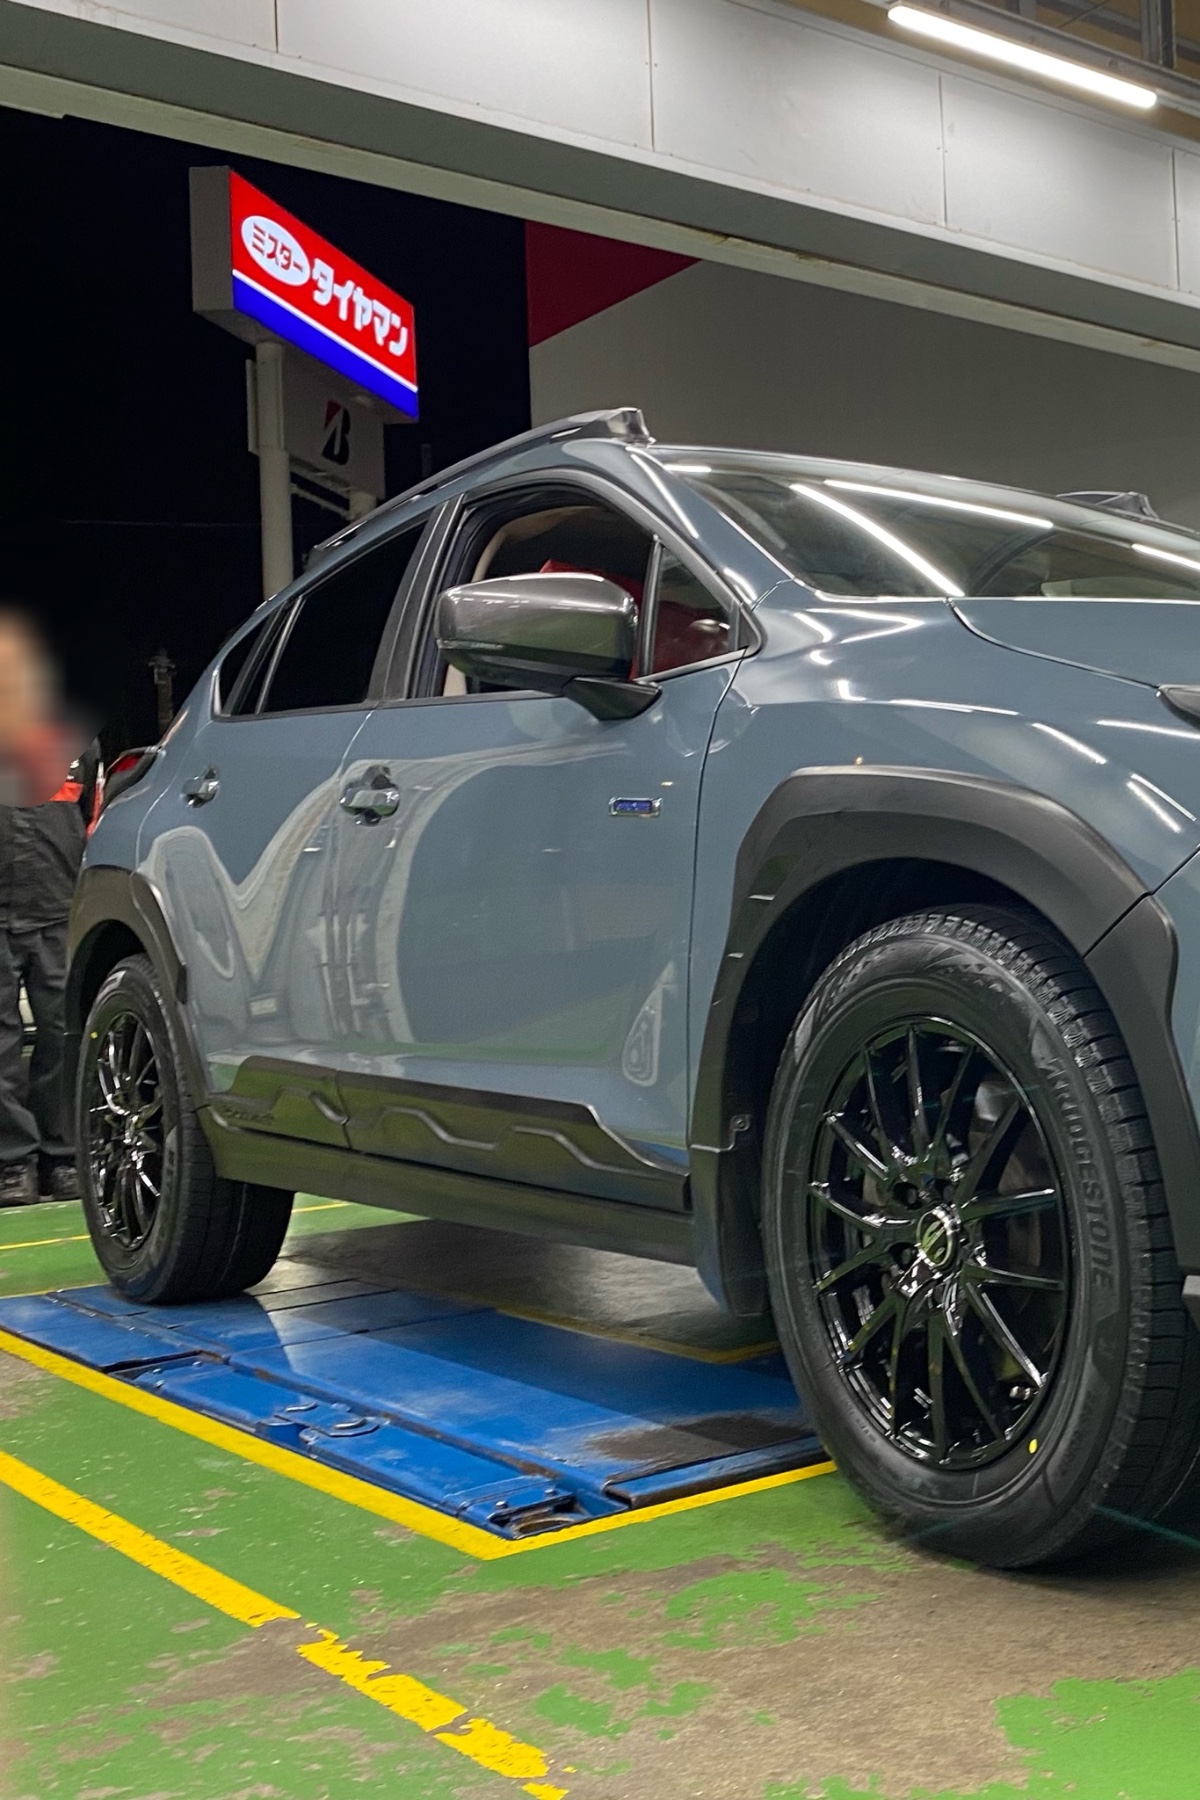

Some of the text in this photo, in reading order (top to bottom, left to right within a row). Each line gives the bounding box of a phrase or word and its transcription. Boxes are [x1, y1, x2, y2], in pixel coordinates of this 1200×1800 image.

[252, 222, 304, 272] ミスター
[312, 257, 408, 356] タイヤマン
[1047, 1056, 1114, 1287] BRIDGESTONE
